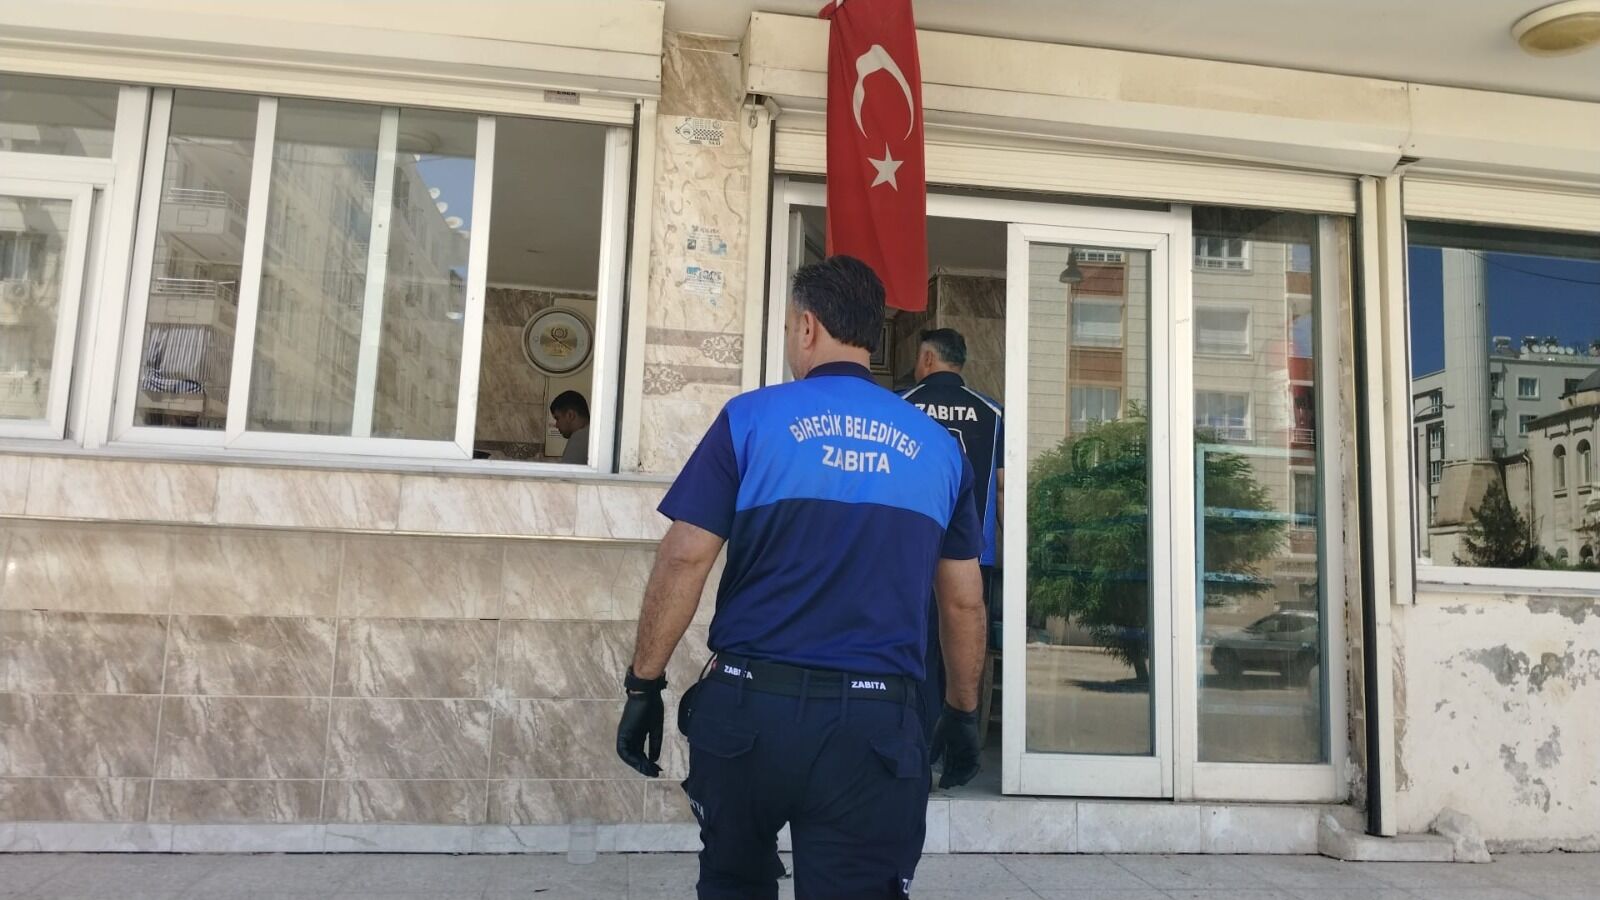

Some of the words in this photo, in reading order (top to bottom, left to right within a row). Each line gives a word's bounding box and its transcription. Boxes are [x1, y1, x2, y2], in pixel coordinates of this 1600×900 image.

[789, 409, 842, 443] BİRECİK
[845, 415, 923, 460] BELEDİYESİ
[822, 444, 891, 474] ZABITA
[851, 680, 887, 690] ZABITA
